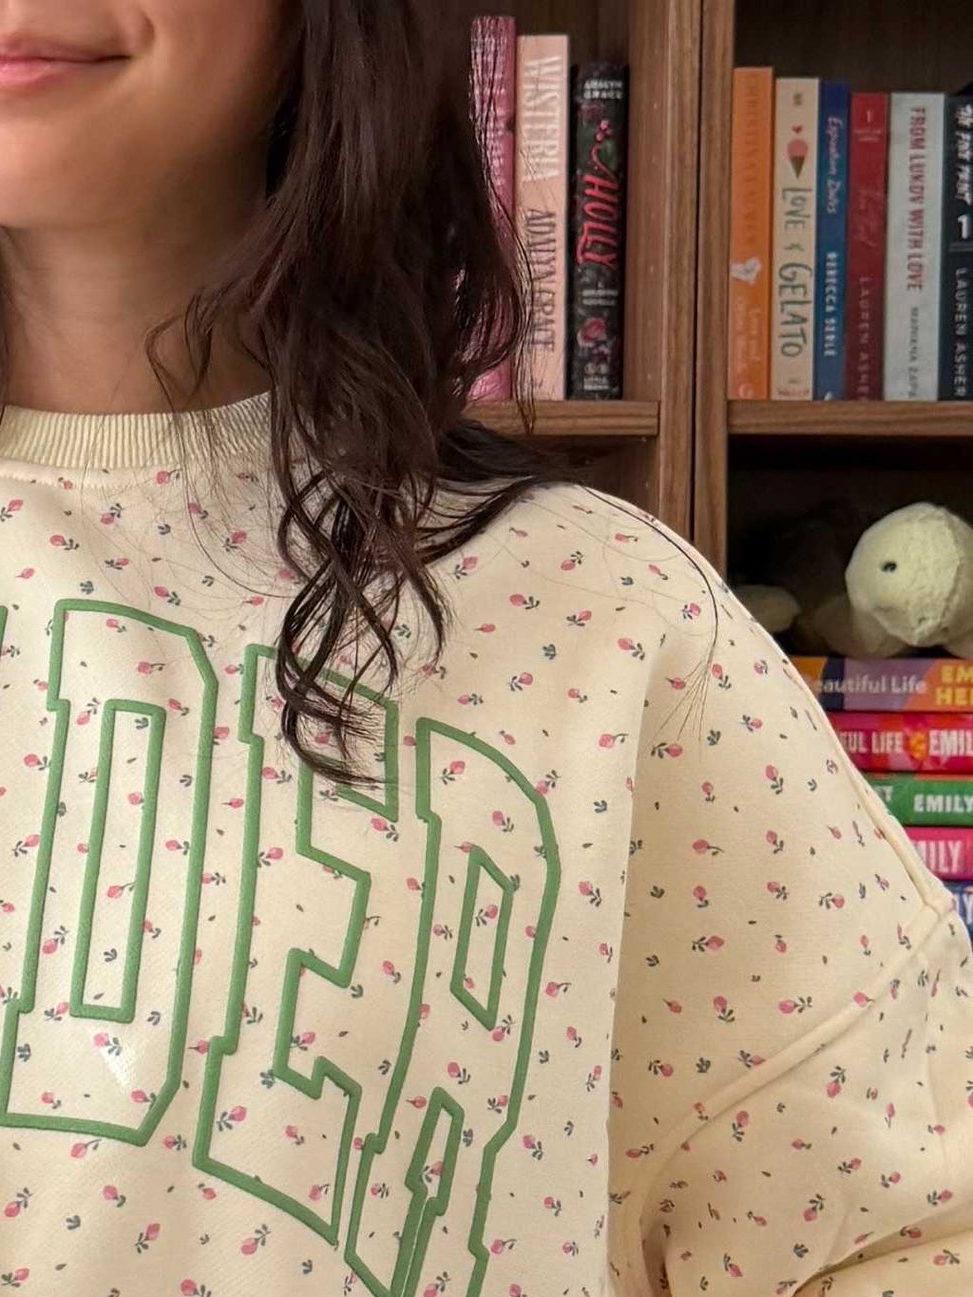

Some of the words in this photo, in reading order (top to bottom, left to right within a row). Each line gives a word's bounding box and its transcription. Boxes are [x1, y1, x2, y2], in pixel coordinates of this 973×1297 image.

[523, 55, 563, 183] WISTERIA
[910, 106, 927, 151] FROM
[908, 153, 926, 205] LUKOV
[576, 174, 620, 269] HOLLY
[782, 187, 812, 229] LOVE
[907, 209, 925, 250] WITH
[825, 251, 839, 312] REBECCA
[906, 253, 924, 293] LOVE
[778, 263, 813, 358] GELATO
[954, 268, 969, 336] LAUREN
[824, 317, 837, 358] SERLE
[953, 343, 968, 397] ASHER
[891, 675, 927, 693] Life
[871, 731, 904, 754] LIFE
[913, 793, 973, 813] EMILY
